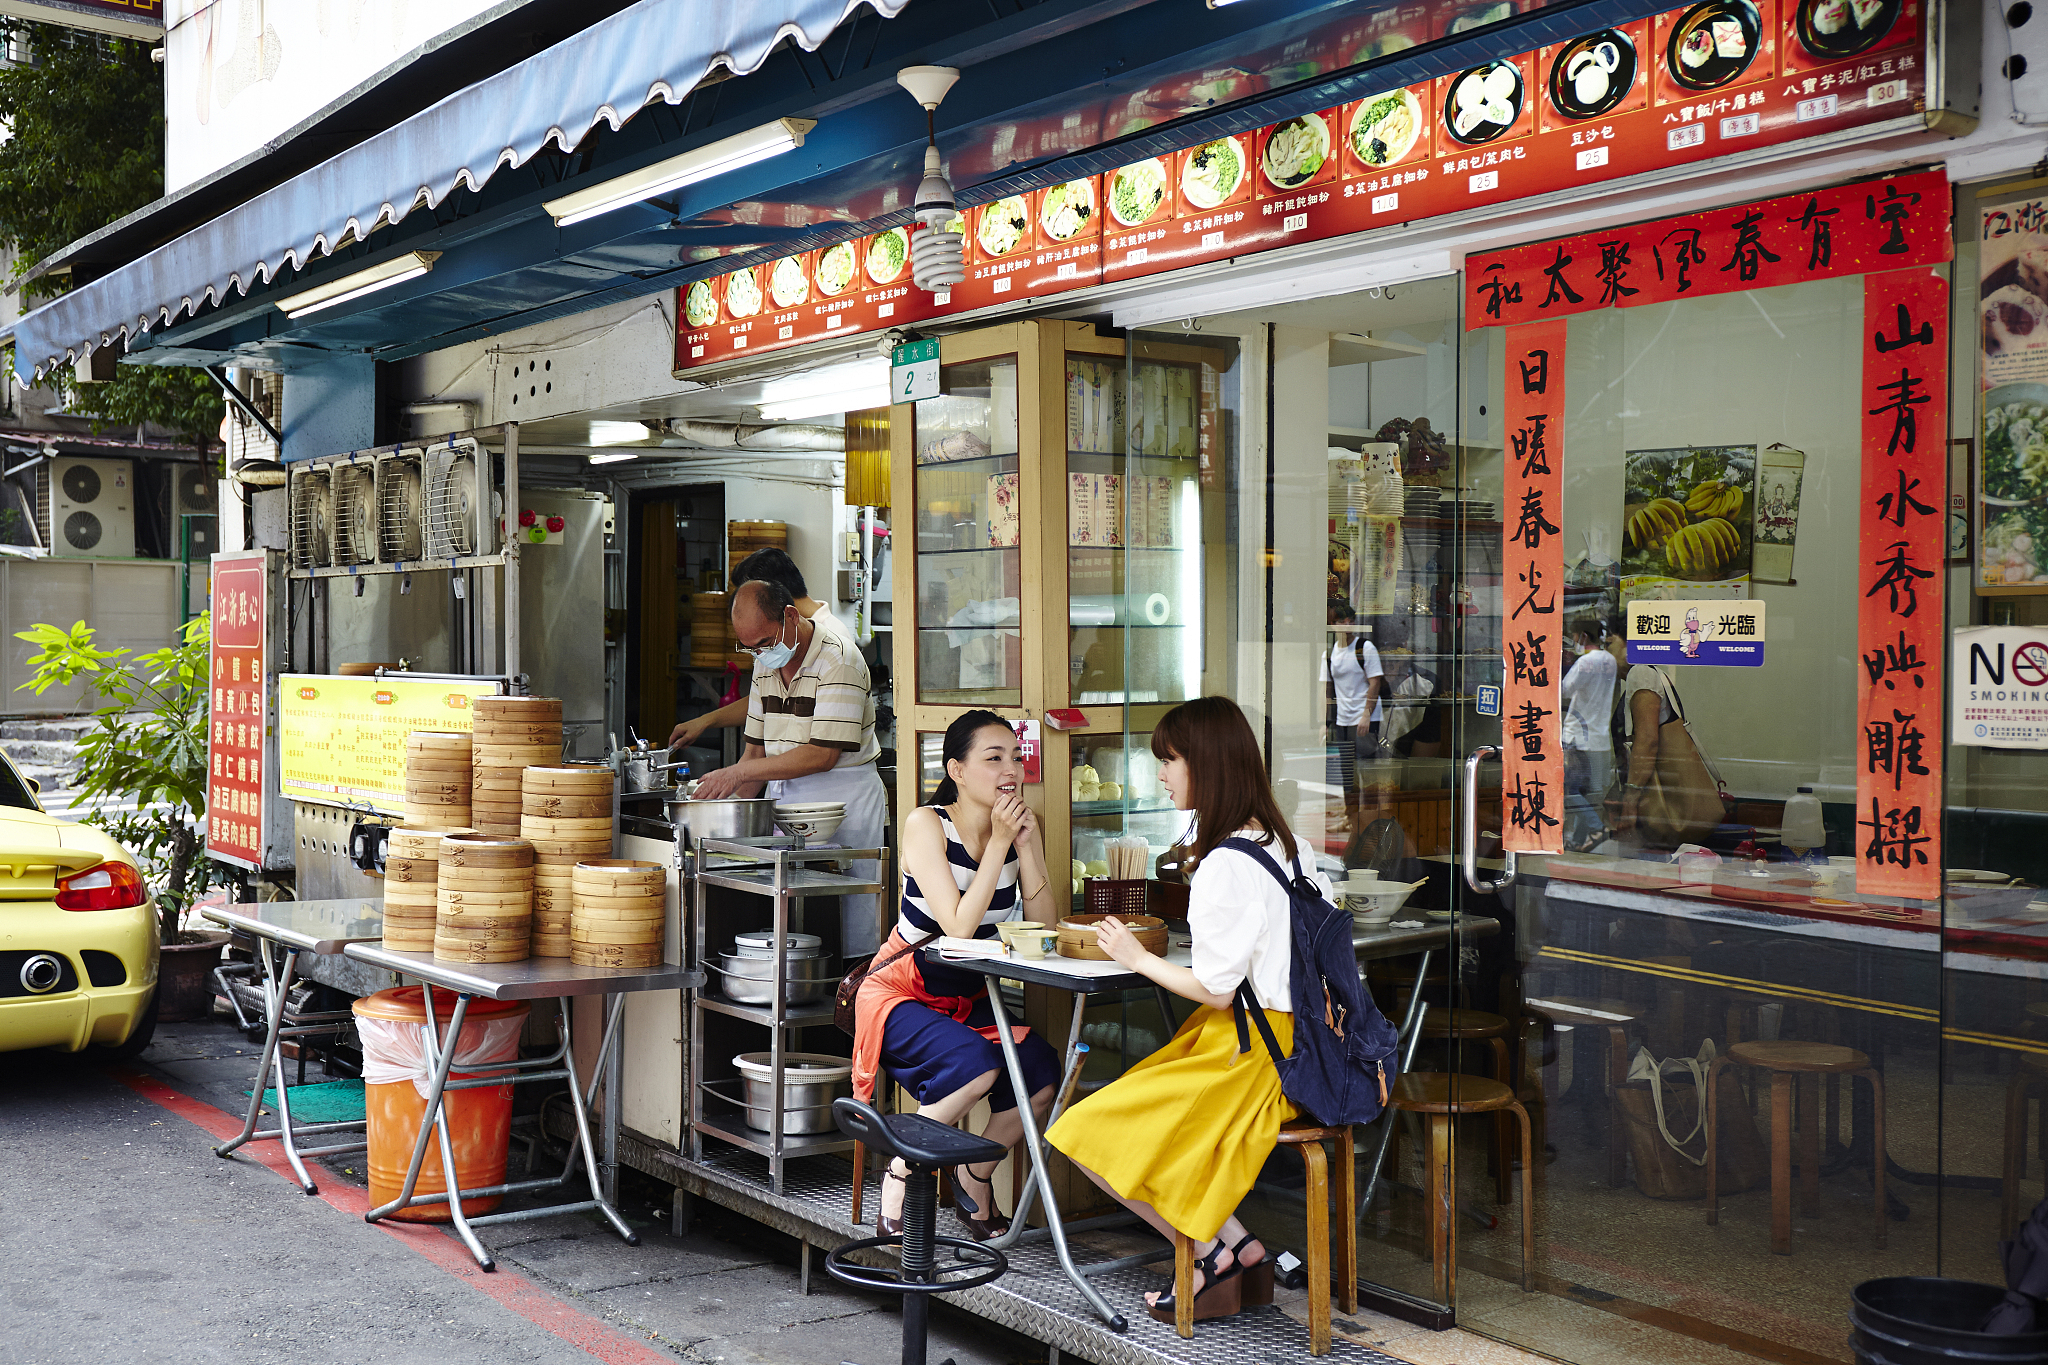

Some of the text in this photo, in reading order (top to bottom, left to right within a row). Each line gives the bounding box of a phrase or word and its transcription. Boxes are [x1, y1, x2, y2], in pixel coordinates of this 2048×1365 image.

[1782, 54, 1916, 97] 八寶芋泥/紅豆糕
[1878, 84, 1895, 100] 30
[1662, 89, 1766, 124] 八寶飯/千層糕
[1570, 124, 1615, 147] 豆沙包
[1442, 145, 1527, 176] 鮮肉包/菜肉包
[1584, 150, 1601, 166] 25
[1342, 167, 1430, 198] 雪菜油豆腐細粉
[1476, 175, 1492, 189] 25
[897, 342, 934, 364] 麗水街
[904, 370, 915, 395] 2
[219, 587, 258, 630] 江浙點心
[1636, 614, 1756, 636] 歡迎 光臨
[1718, 645, 1756, 653] WELCOME
[215, 656, 260, 683] 小籠包
[215, 687, 260, 717] 蟹黃小包
[1481, 689, 1496, 705] 拉
[214, 721, 259, 751] 菜肉蒸餃
[213, 753, 259, 785] 蝦仁燒賣
[212, 785, 258, 818] 油豆腐細粉
